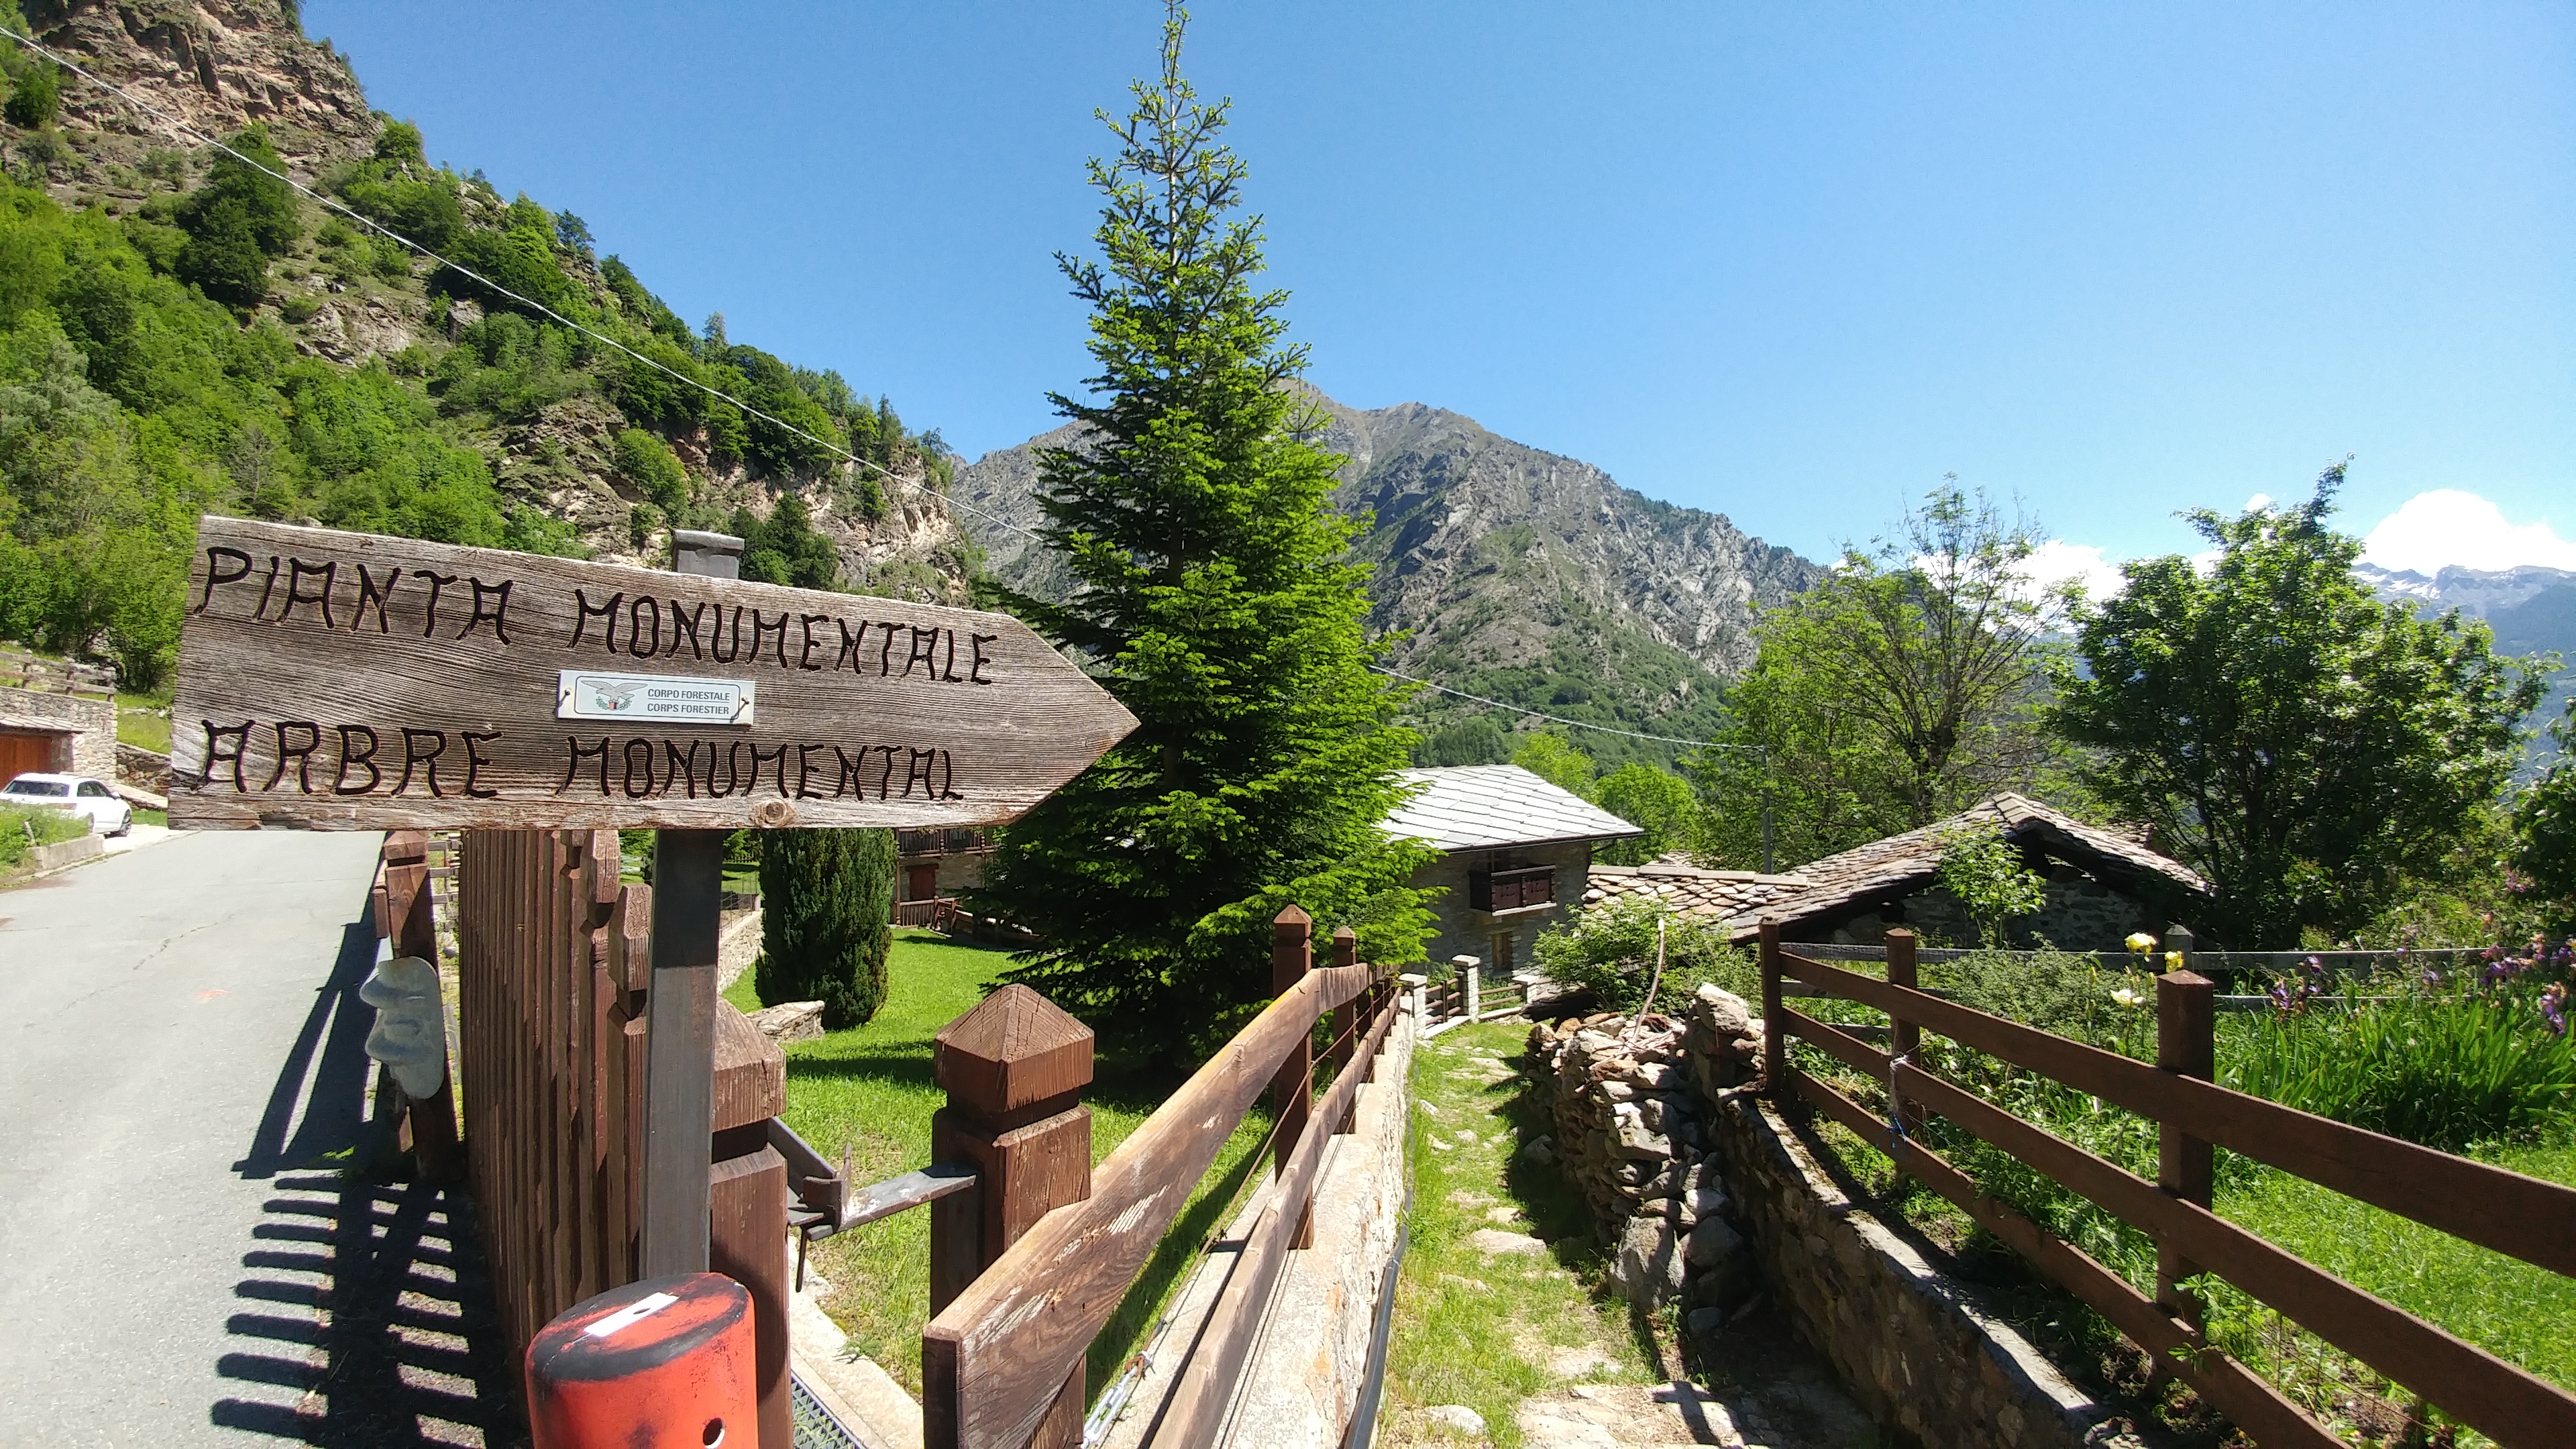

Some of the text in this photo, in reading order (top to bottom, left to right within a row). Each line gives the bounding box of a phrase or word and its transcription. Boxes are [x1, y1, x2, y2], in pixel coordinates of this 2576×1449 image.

[194, 547, 998, 685] PIANTA MONUMENTALE
[647, 689, 730, 701] CORPO FORESTALE
[647, 703, 729, 714] CORPS FORESTIER
[199, 719, 964, 801] ARBRE MONUMENTAL
